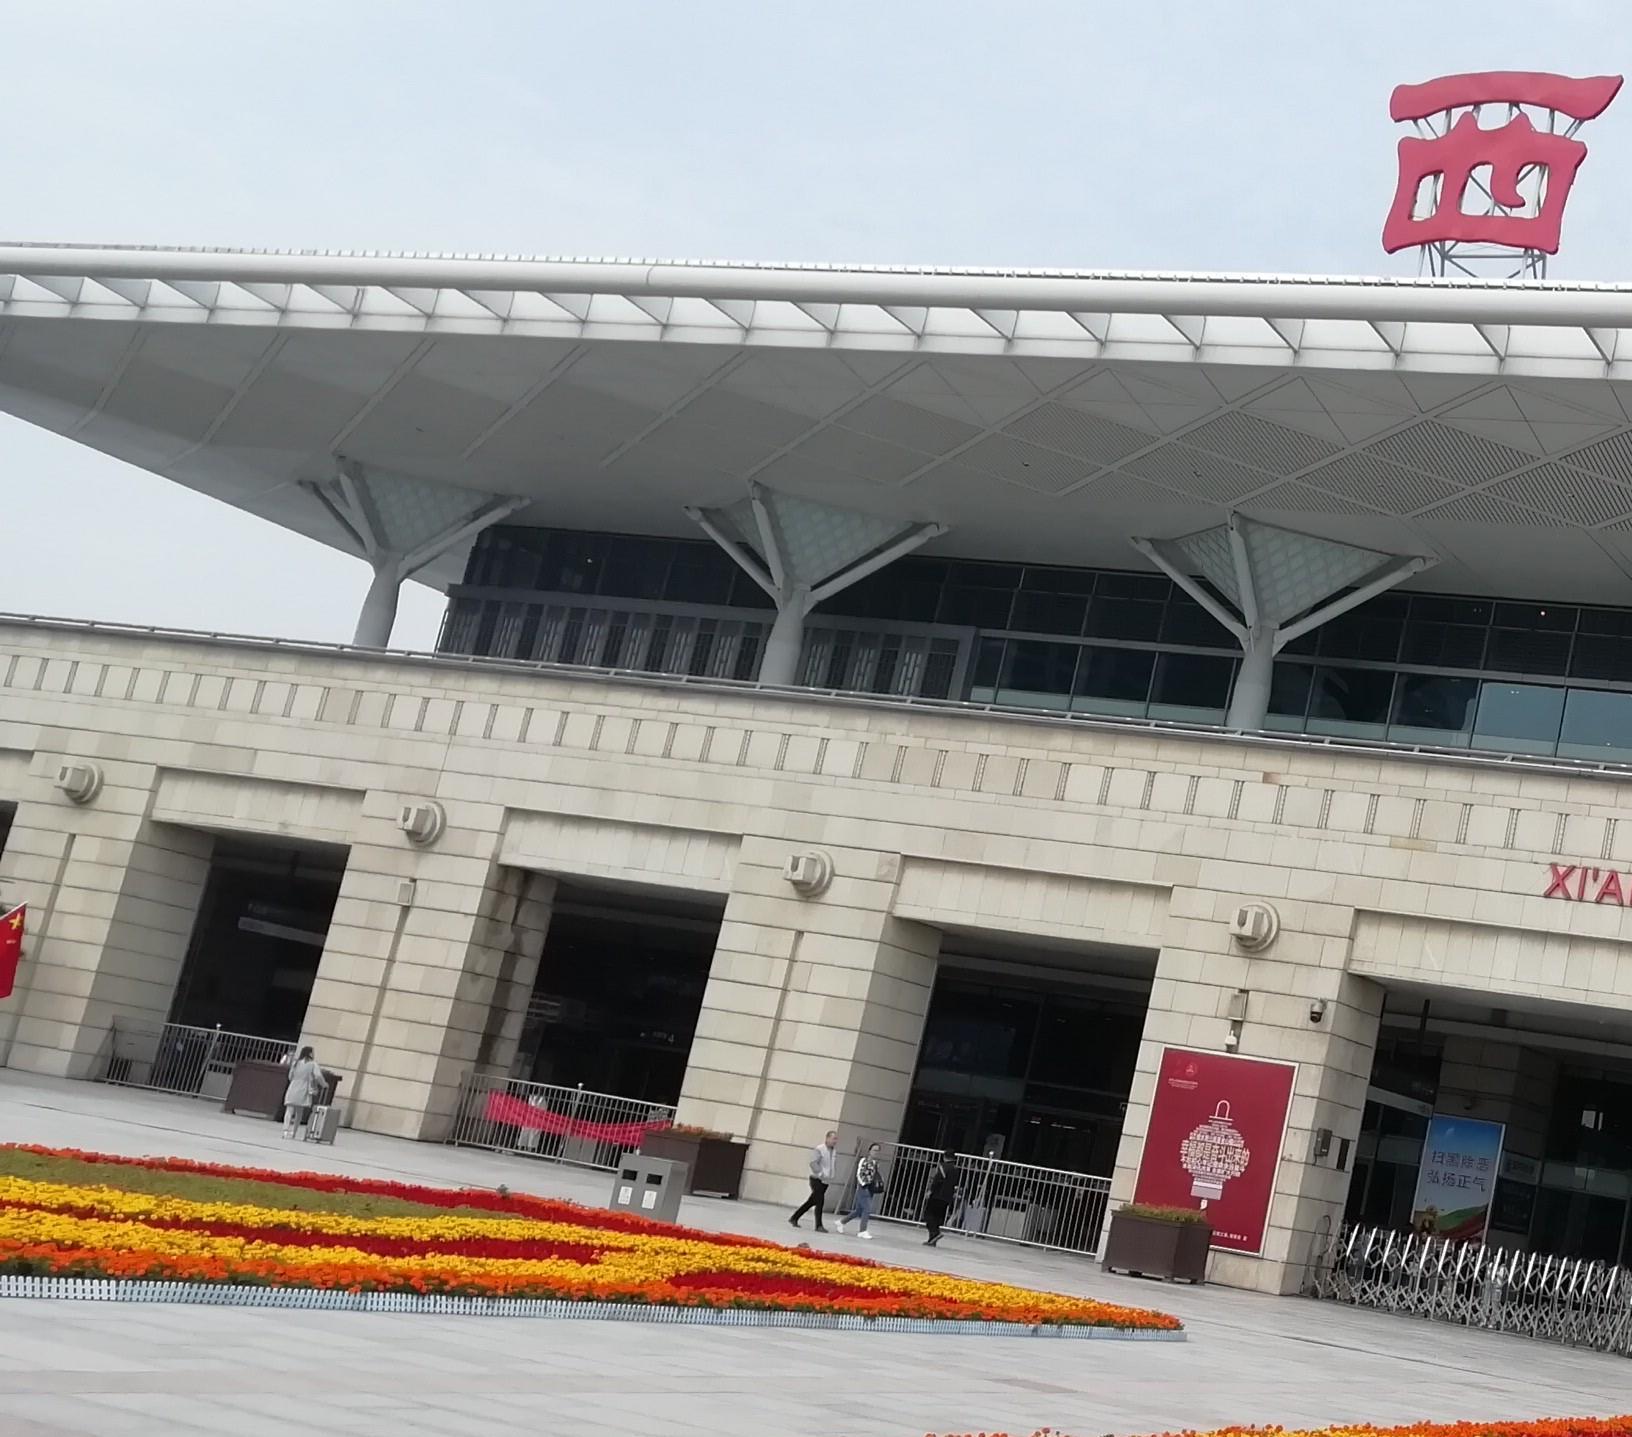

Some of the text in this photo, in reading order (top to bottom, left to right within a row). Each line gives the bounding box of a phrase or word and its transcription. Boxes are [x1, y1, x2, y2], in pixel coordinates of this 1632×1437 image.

[1431, 1150, 1490, 1172] 扫黑除恶
[1426, 1168, 1488, 1193] 弘扬正气
